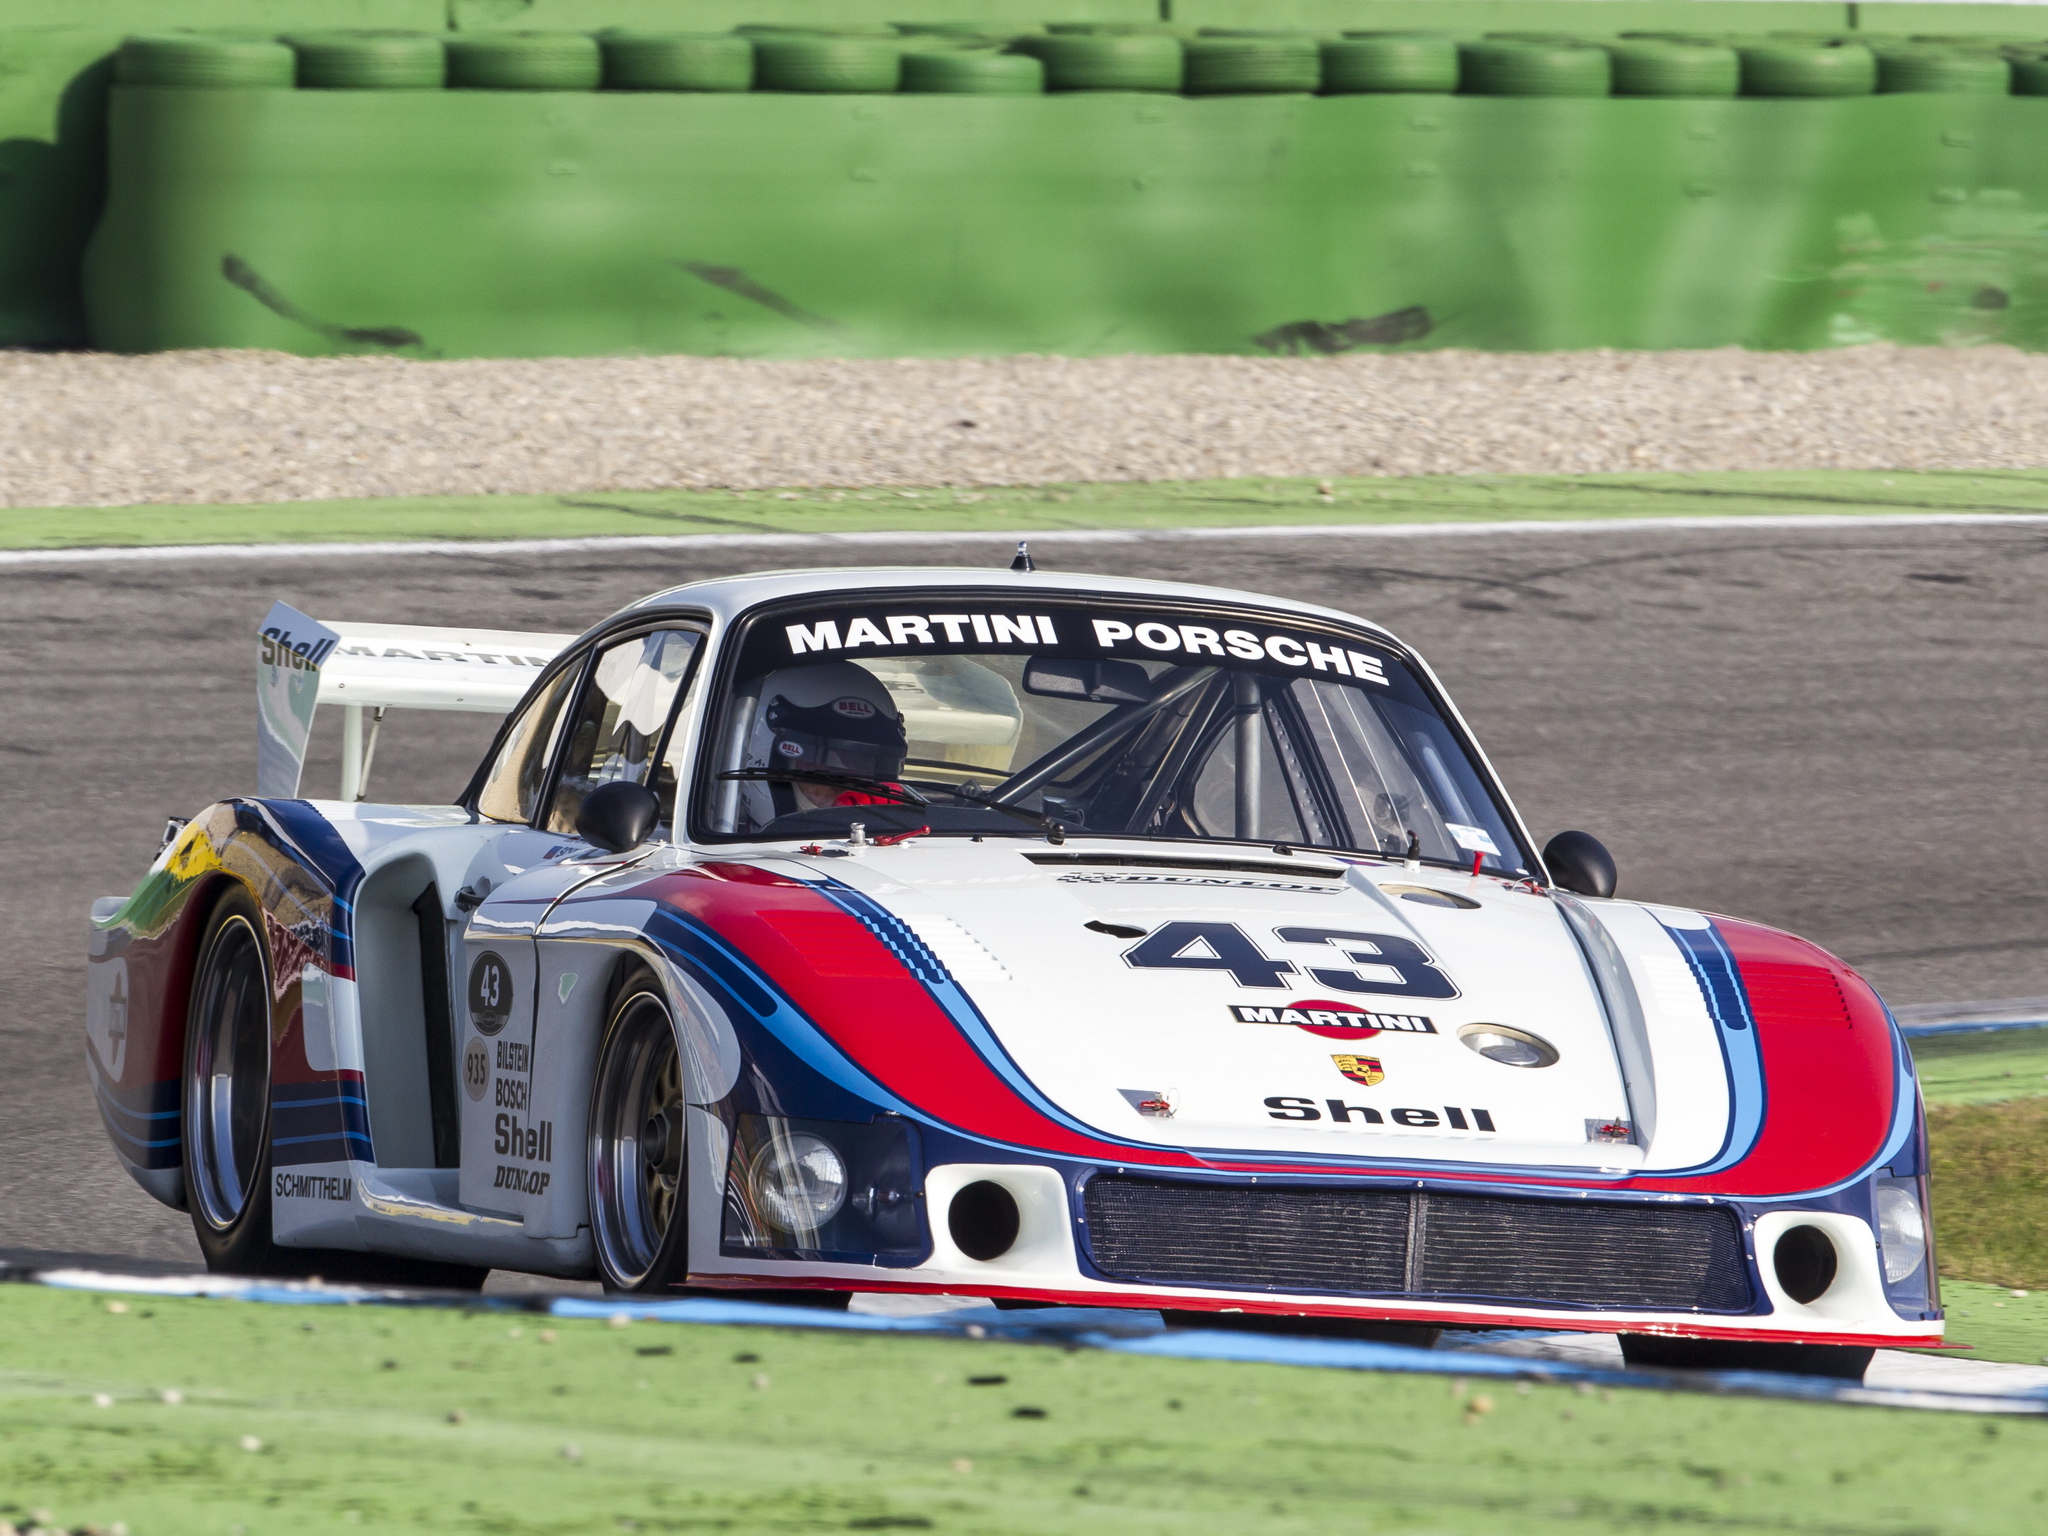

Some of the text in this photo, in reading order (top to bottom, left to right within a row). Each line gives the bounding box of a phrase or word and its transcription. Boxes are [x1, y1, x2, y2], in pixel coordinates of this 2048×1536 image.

[261, 627, 335, 672] Shell
[785, 614, 1390, 686] MARTINI PORSCHE
[838, 701, 872, 713] BELL
[782, 743, 800, 754] BELL
[1122, 876, 1342, 891] DUNLOP
[1120, 920, 1463, 1001] 43
[481, 965, 500, 1007] 43
[1238, 1007, 1428, 1032] MARTINI
[467, 1053, 486, 1085] 935
[496, 1040, 529, 1073] BILSTEIN
[495, 1077, 528, 1111] BOSCH
[1263, 1096, 1497, 1132] Shell
[494, 1113, 553, 1163] Shell
[275, 1173, 352, 1201] SCHMITTHELM
[493, 1165, 550, 1195] DUNLOP
